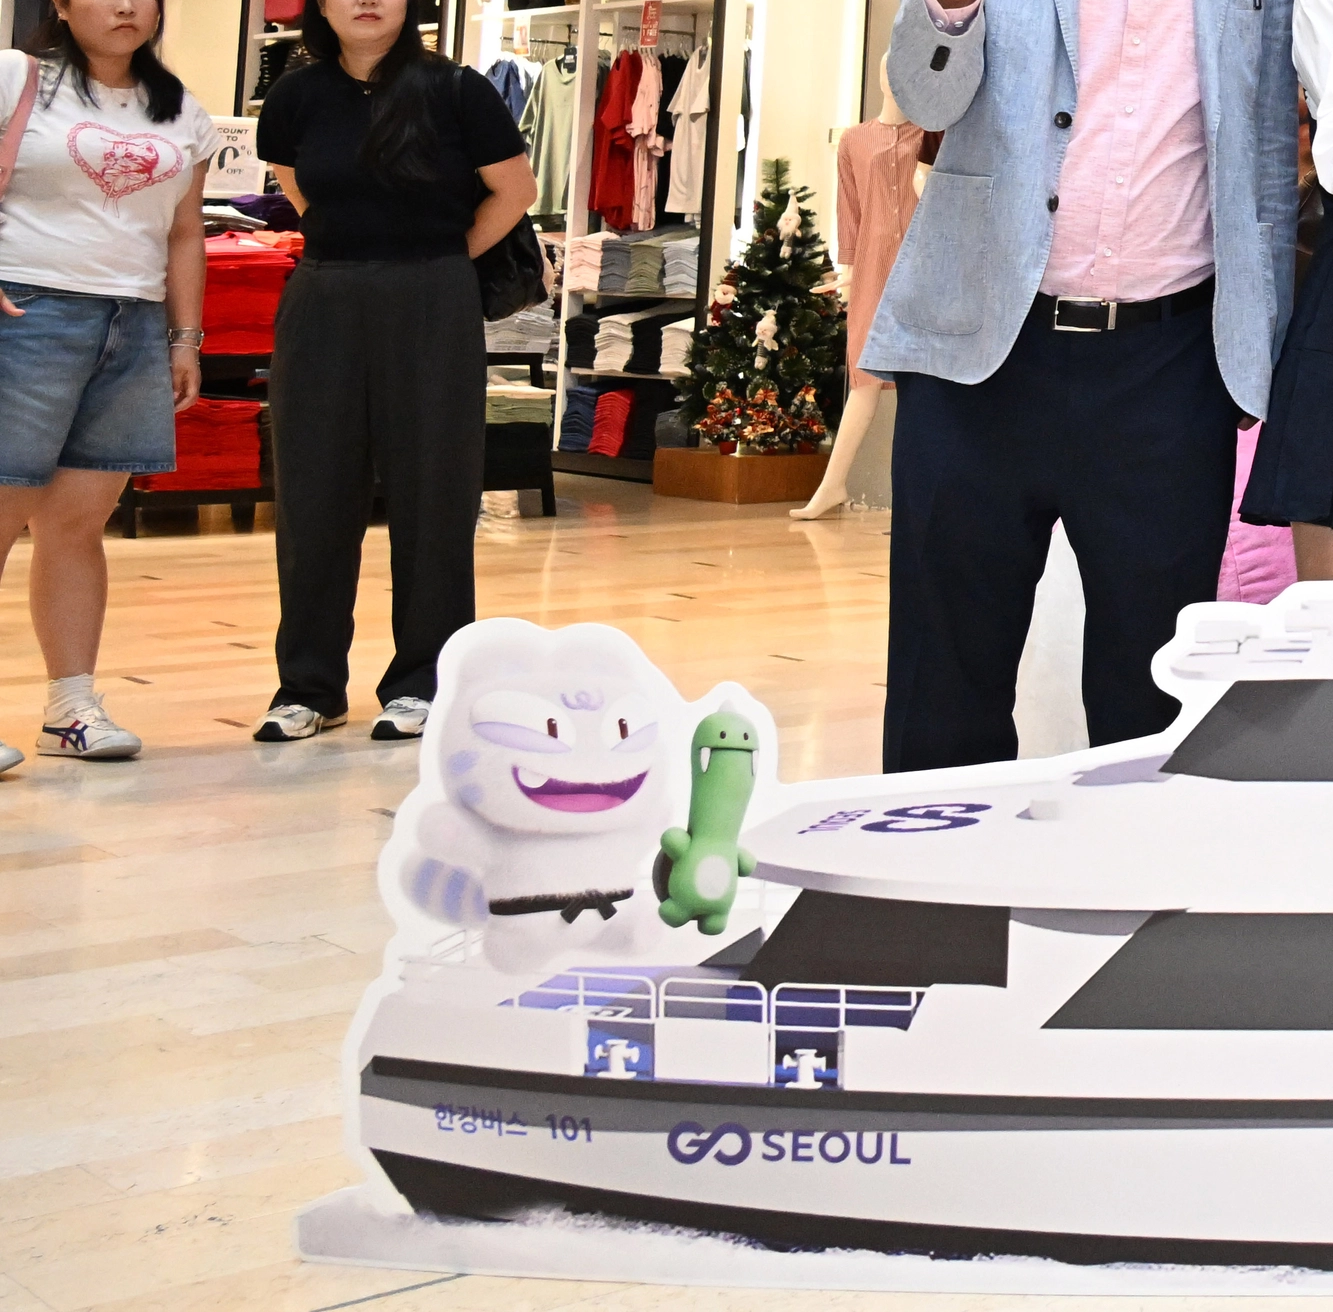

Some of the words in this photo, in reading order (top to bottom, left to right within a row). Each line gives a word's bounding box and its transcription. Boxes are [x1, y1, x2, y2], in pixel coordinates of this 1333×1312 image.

[217, 127, 249, 135] COUNT
[432, 1102, 527, 1137] 한강버스
[545, 1113, 593, 1143] 101
[761, 1129, 912, 1166] SEOUL
